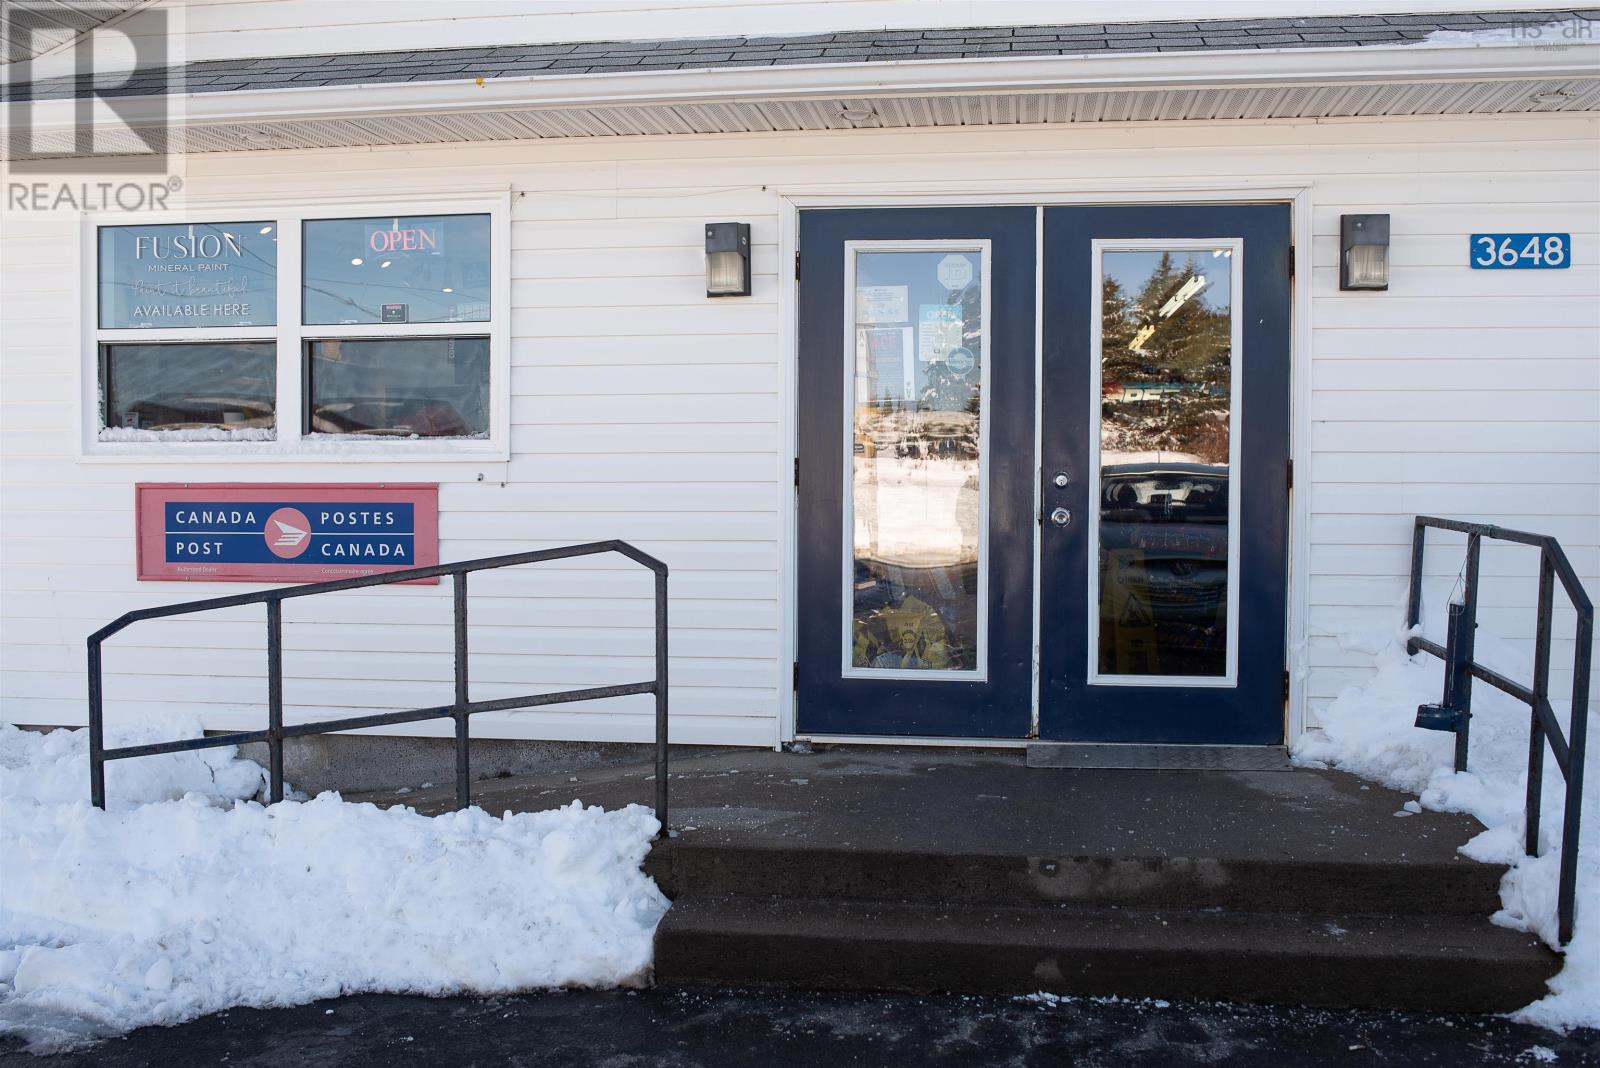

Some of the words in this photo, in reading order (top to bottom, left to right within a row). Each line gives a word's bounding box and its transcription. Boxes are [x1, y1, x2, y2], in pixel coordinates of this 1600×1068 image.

[135, 234, 243, 260] FUSION
[370, 228, 436, 252] OPEN
[1476, 236, 1564, 266] 3648
[148, 264, 194, 272] MINERAL
[198, 263, 229, 272] PAINT
[133, 304, 208, 317] AVAILABLE
[213, 303, 250, 316] HERE
[175, 510, 257, 525] CANADA
[320, 511, 395, 526] POSTES
[175, 541, 224, 556] POST
[320, 543, 406, 557] CANADA
